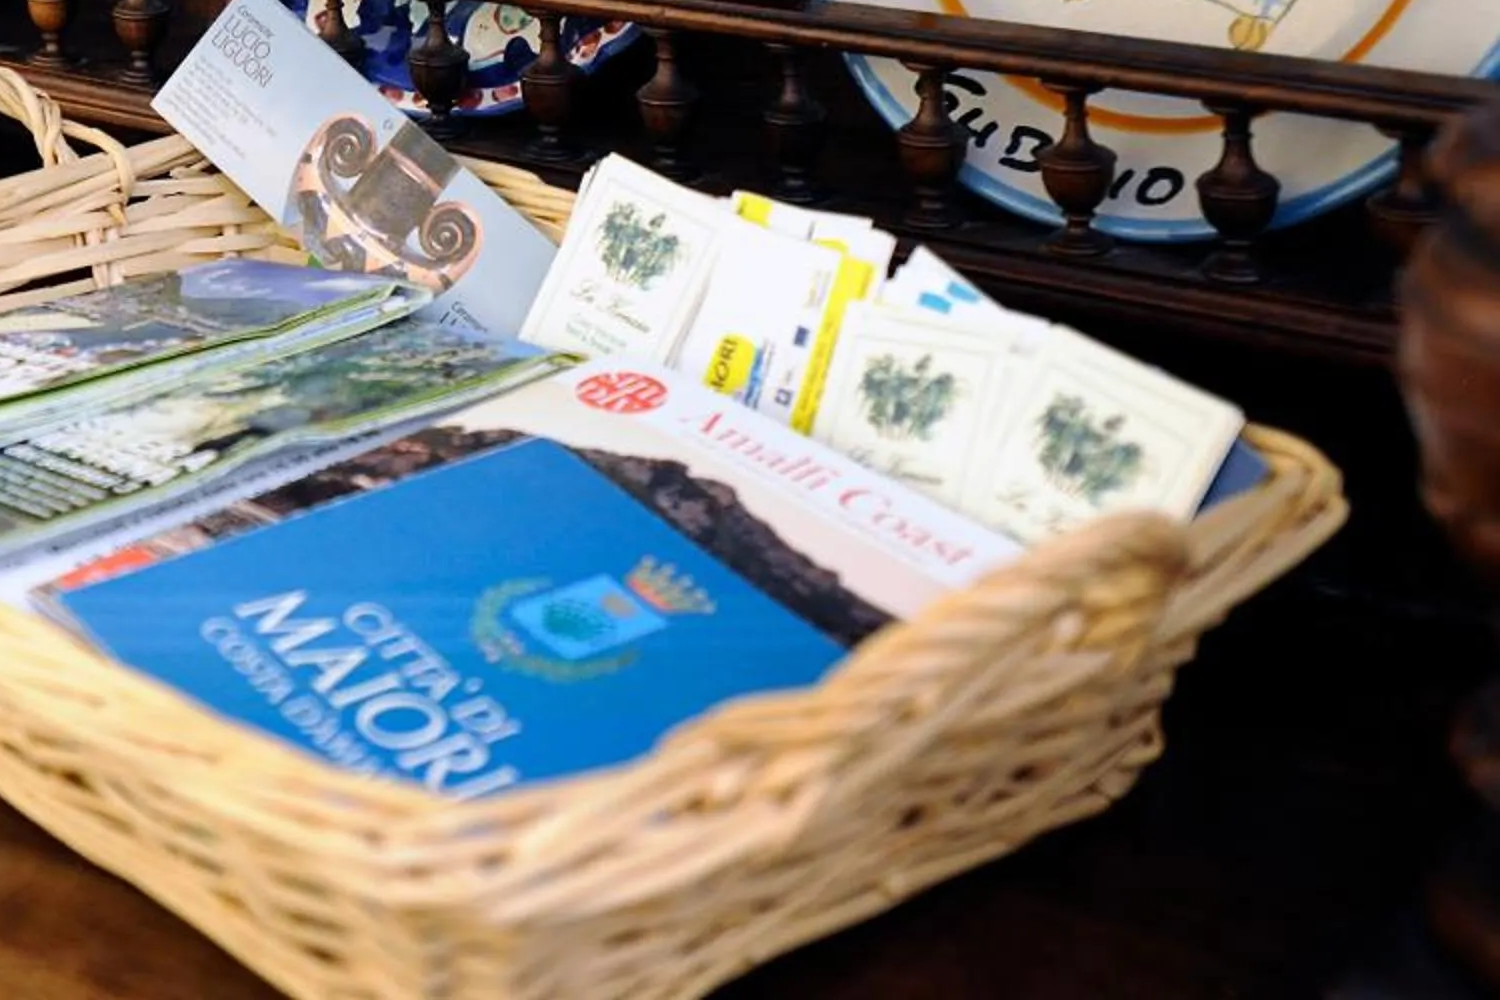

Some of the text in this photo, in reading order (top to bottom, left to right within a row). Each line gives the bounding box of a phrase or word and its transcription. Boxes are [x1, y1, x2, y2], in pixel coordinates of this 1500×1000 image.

[212, 29, 274, 88] LIGUORI
[224, 13, 271, 59] LUCIO
[914, 73, 1185, 206] GUBIO
[679, 410, 841, 491] Amalfi
[838, 484, 974, 565] Coast
[201, 615, 295, 705] COSTA
[233, 588, 521, 801] MAIORI
[451, 694, 522, 744] DI
